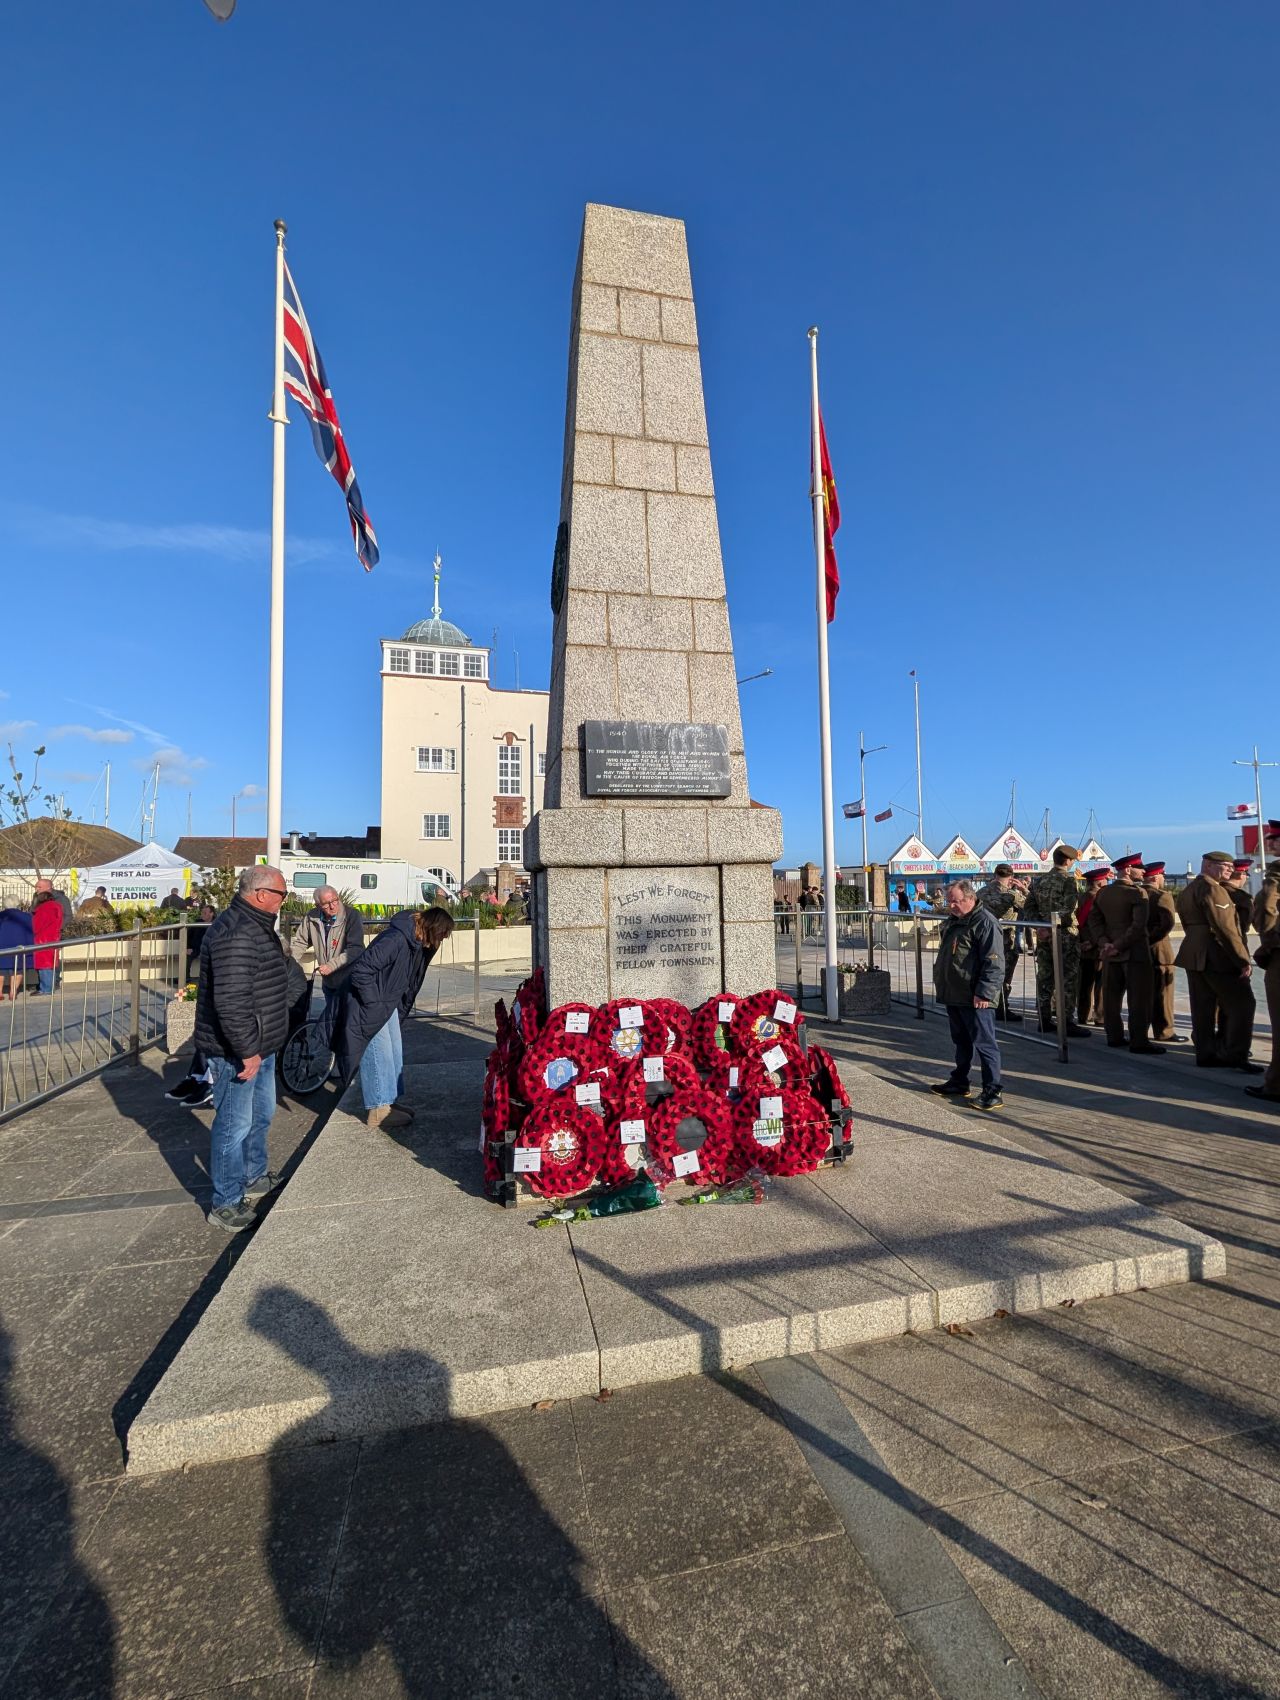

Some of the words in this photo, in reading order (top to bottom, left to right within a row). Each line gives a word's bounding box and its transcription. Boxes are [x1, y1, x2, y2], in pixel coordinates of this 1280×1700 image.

[111, 892, 157, 900] LEADING
[647, 885, 664, 898] WE
[615, 914, 642, 926] THIS
[649, 913, 713, 924] MONUMENT
[616, 930, 639, 940] WAS
[646, 928, 697, 939] ERECTED
[701, 927, 713, 937] BY
[616, 944, 647, 954] THEIR
[659, 942, 714, 953] GRATEFUL
[615, 959, 656, 970] FELLOW
